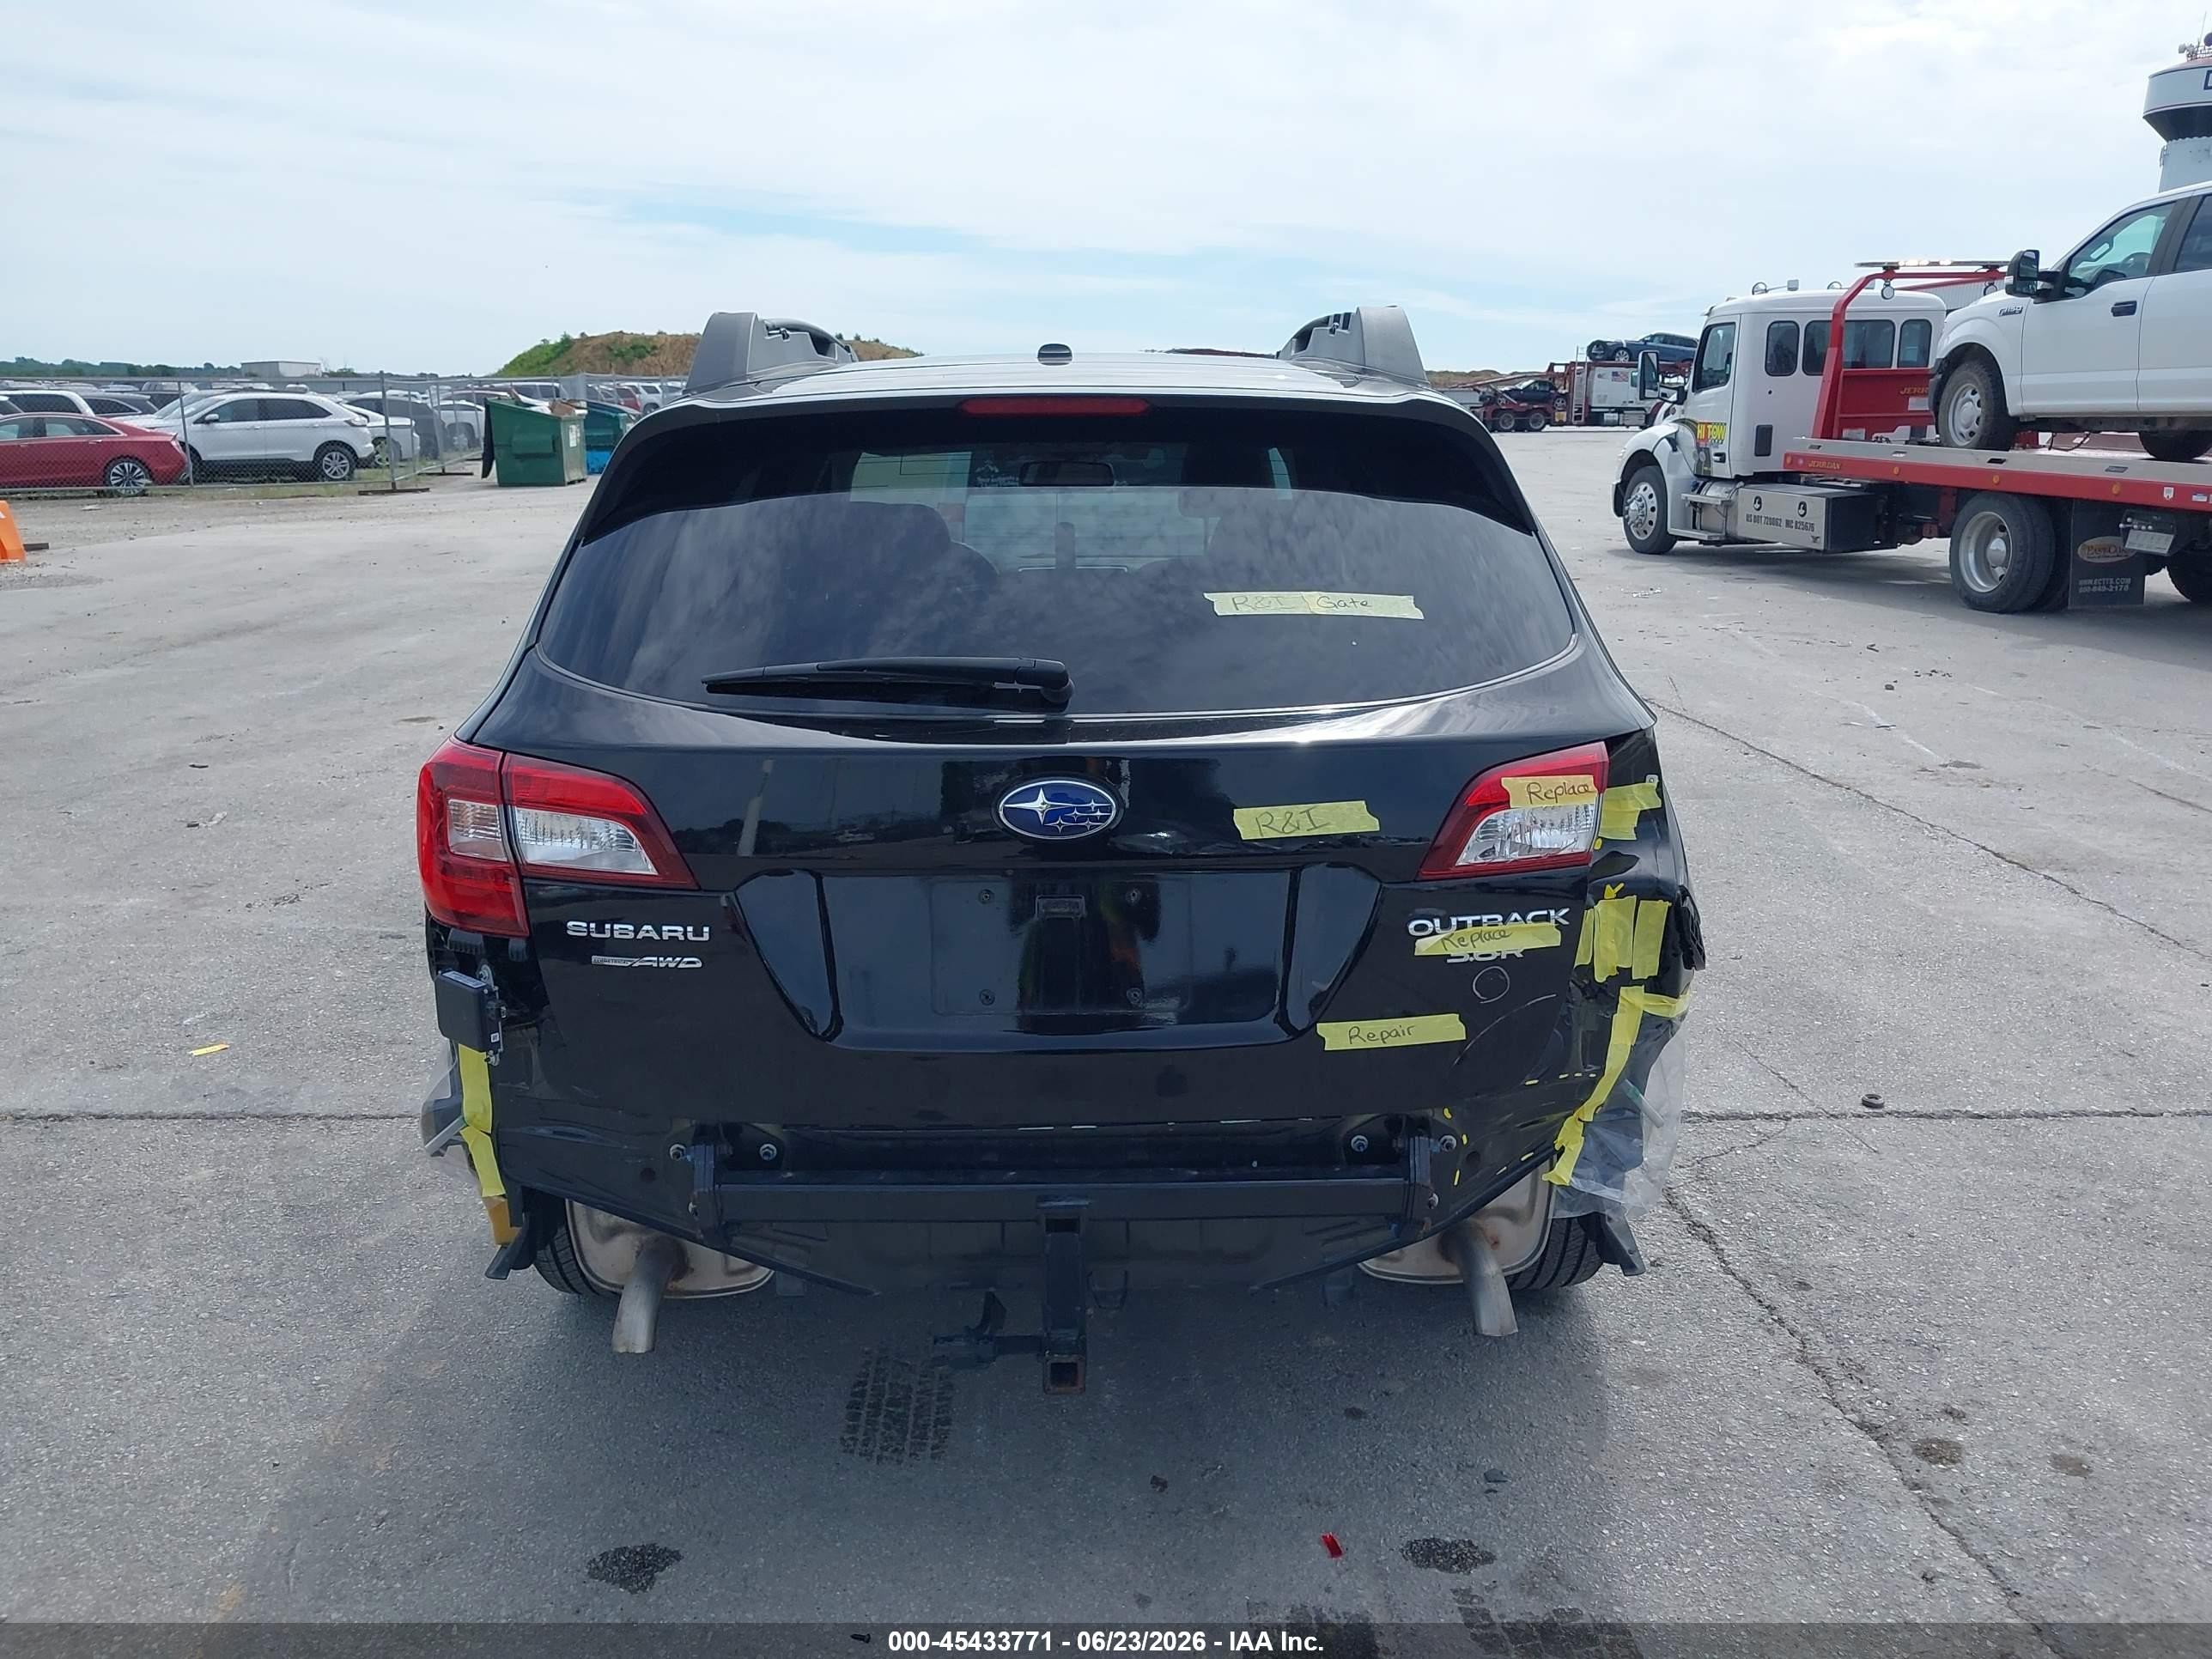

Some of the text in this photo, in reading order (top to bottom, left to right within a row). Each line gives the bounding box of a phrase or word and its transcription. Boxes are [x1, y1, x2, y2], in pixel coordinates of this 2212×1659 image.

[1697, 424, 1726, 440] HI TOW
[1232, 595, 1373, 611] R&I Gate
[1527, 781, 1595, 804] Replace
[1255, 805, 1332, 836] R&I
[566, 921, 710, 941] SUBARU
[1407, 907, 1571, 937] OUTBACK
[1440, 928, 1513, 951] Replace
[631, 956, 702, 969] AWD
[1348, 1024, 1417, 1045] Repair
